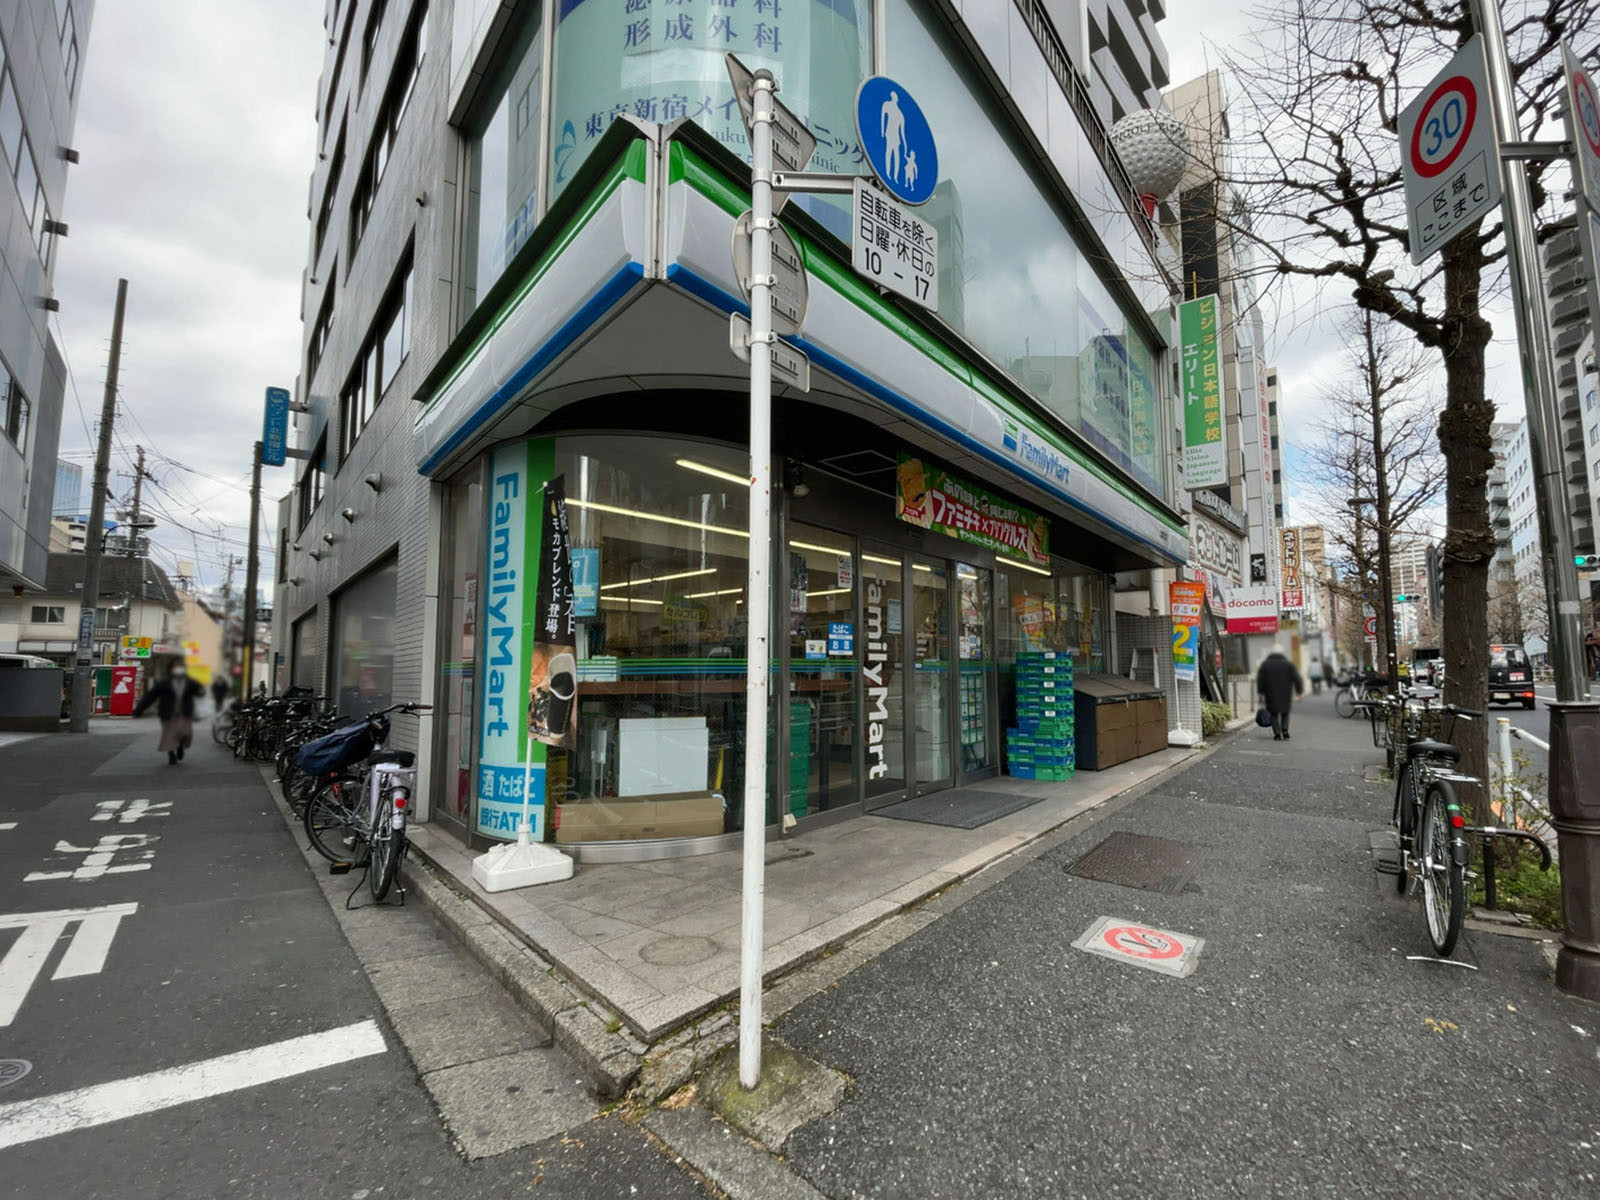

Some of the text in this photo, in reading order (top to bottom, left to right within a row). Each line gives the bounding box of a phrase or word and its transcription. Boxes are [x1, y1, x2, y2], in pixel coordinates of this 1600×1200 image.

[624, 13, 782, 53] 形成外科
[1424, 98, 1463, 156] 30
[861, 189, 934, 252] 自転車を除く
[1423, 182, 1485, 243] ここまで
[1433, 171, 1468, 213] 区域
[865, 247, 882, 275] 10
[915, 274, 930, 301] 17
[1184, 343, 1199, 405] エリート
[1200, 299, 1221, 442] ビジョン日本語学校
[1020, 432, 1070, 485] FamilyMart
[487, 472, 519, 738] FamilyMart
[1228, 599, 1274, 608] docomo
[863, 577, 888, 780] amilyMart
